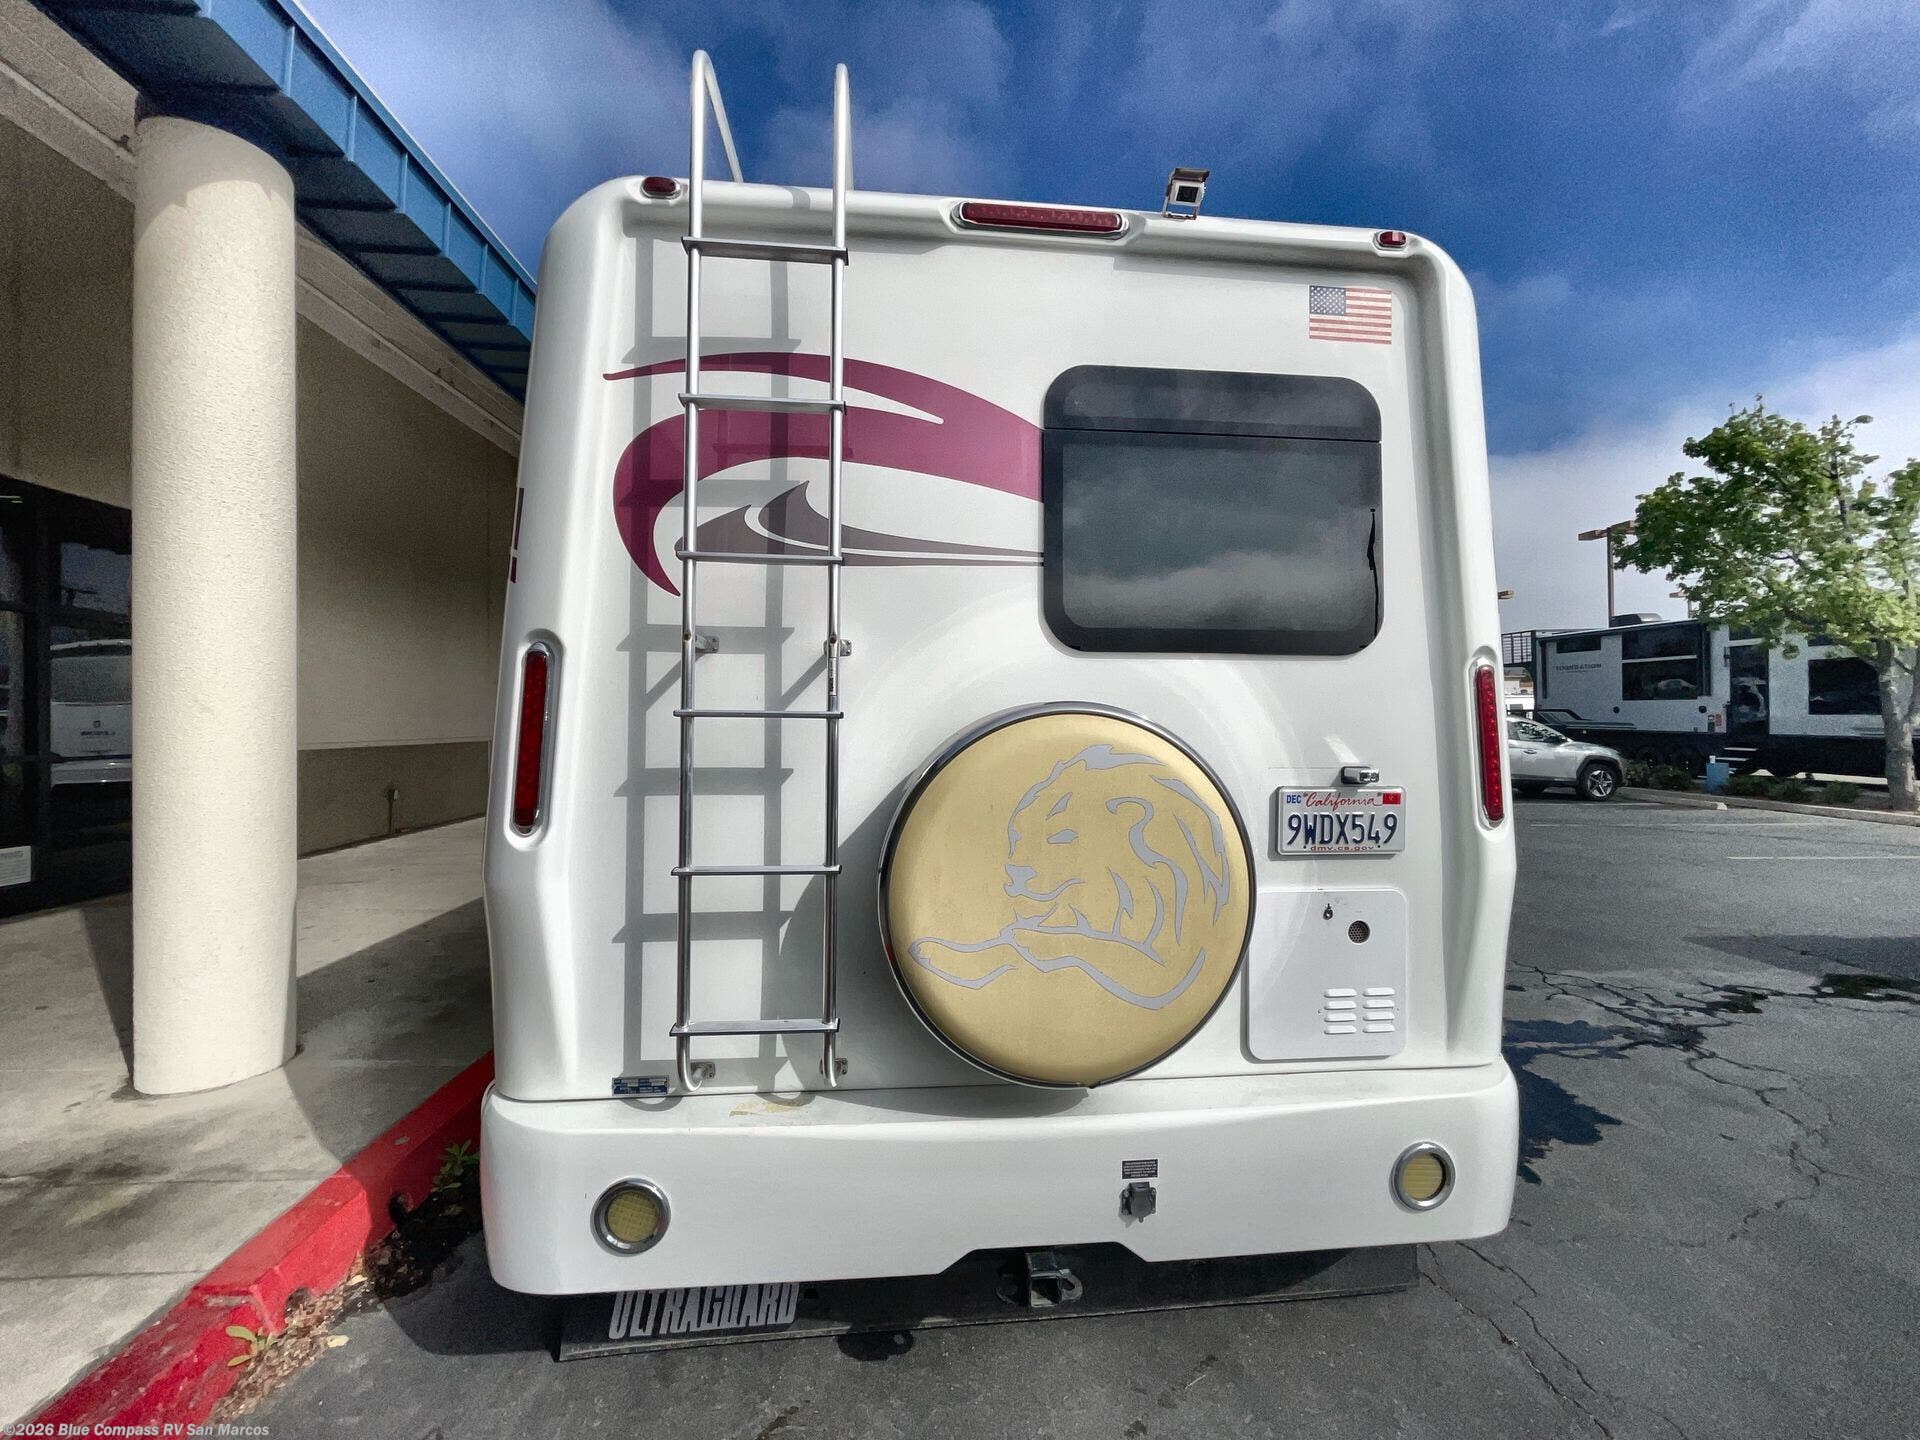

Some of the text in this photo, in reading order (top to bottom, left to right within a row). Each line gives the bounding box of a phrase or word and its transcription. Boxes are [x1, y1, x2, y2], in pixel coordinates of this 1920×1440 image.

[1286, 792, 1382, 812] DEC California
[1287, 812, 1398, 846] 9WDX549
[608, 1282, 800, 1340] ULTRAGUARD
